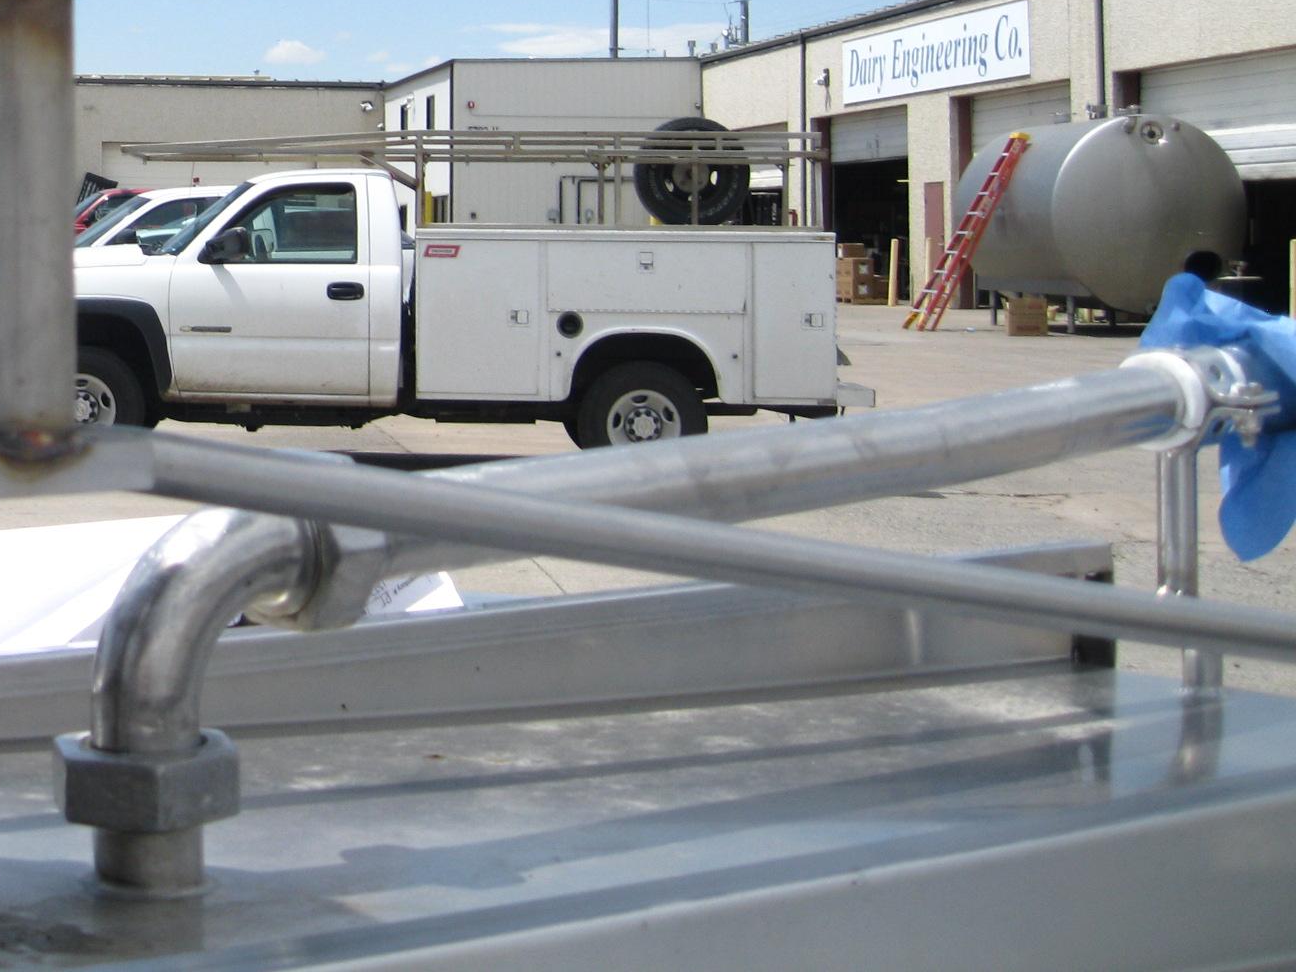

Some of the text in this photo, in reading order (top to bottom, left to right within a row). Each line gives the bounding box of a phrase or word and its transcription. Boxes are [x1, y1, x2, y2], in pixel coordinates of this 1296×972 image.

[848, 14, 1022, 93] Dairy Engineering Co.
